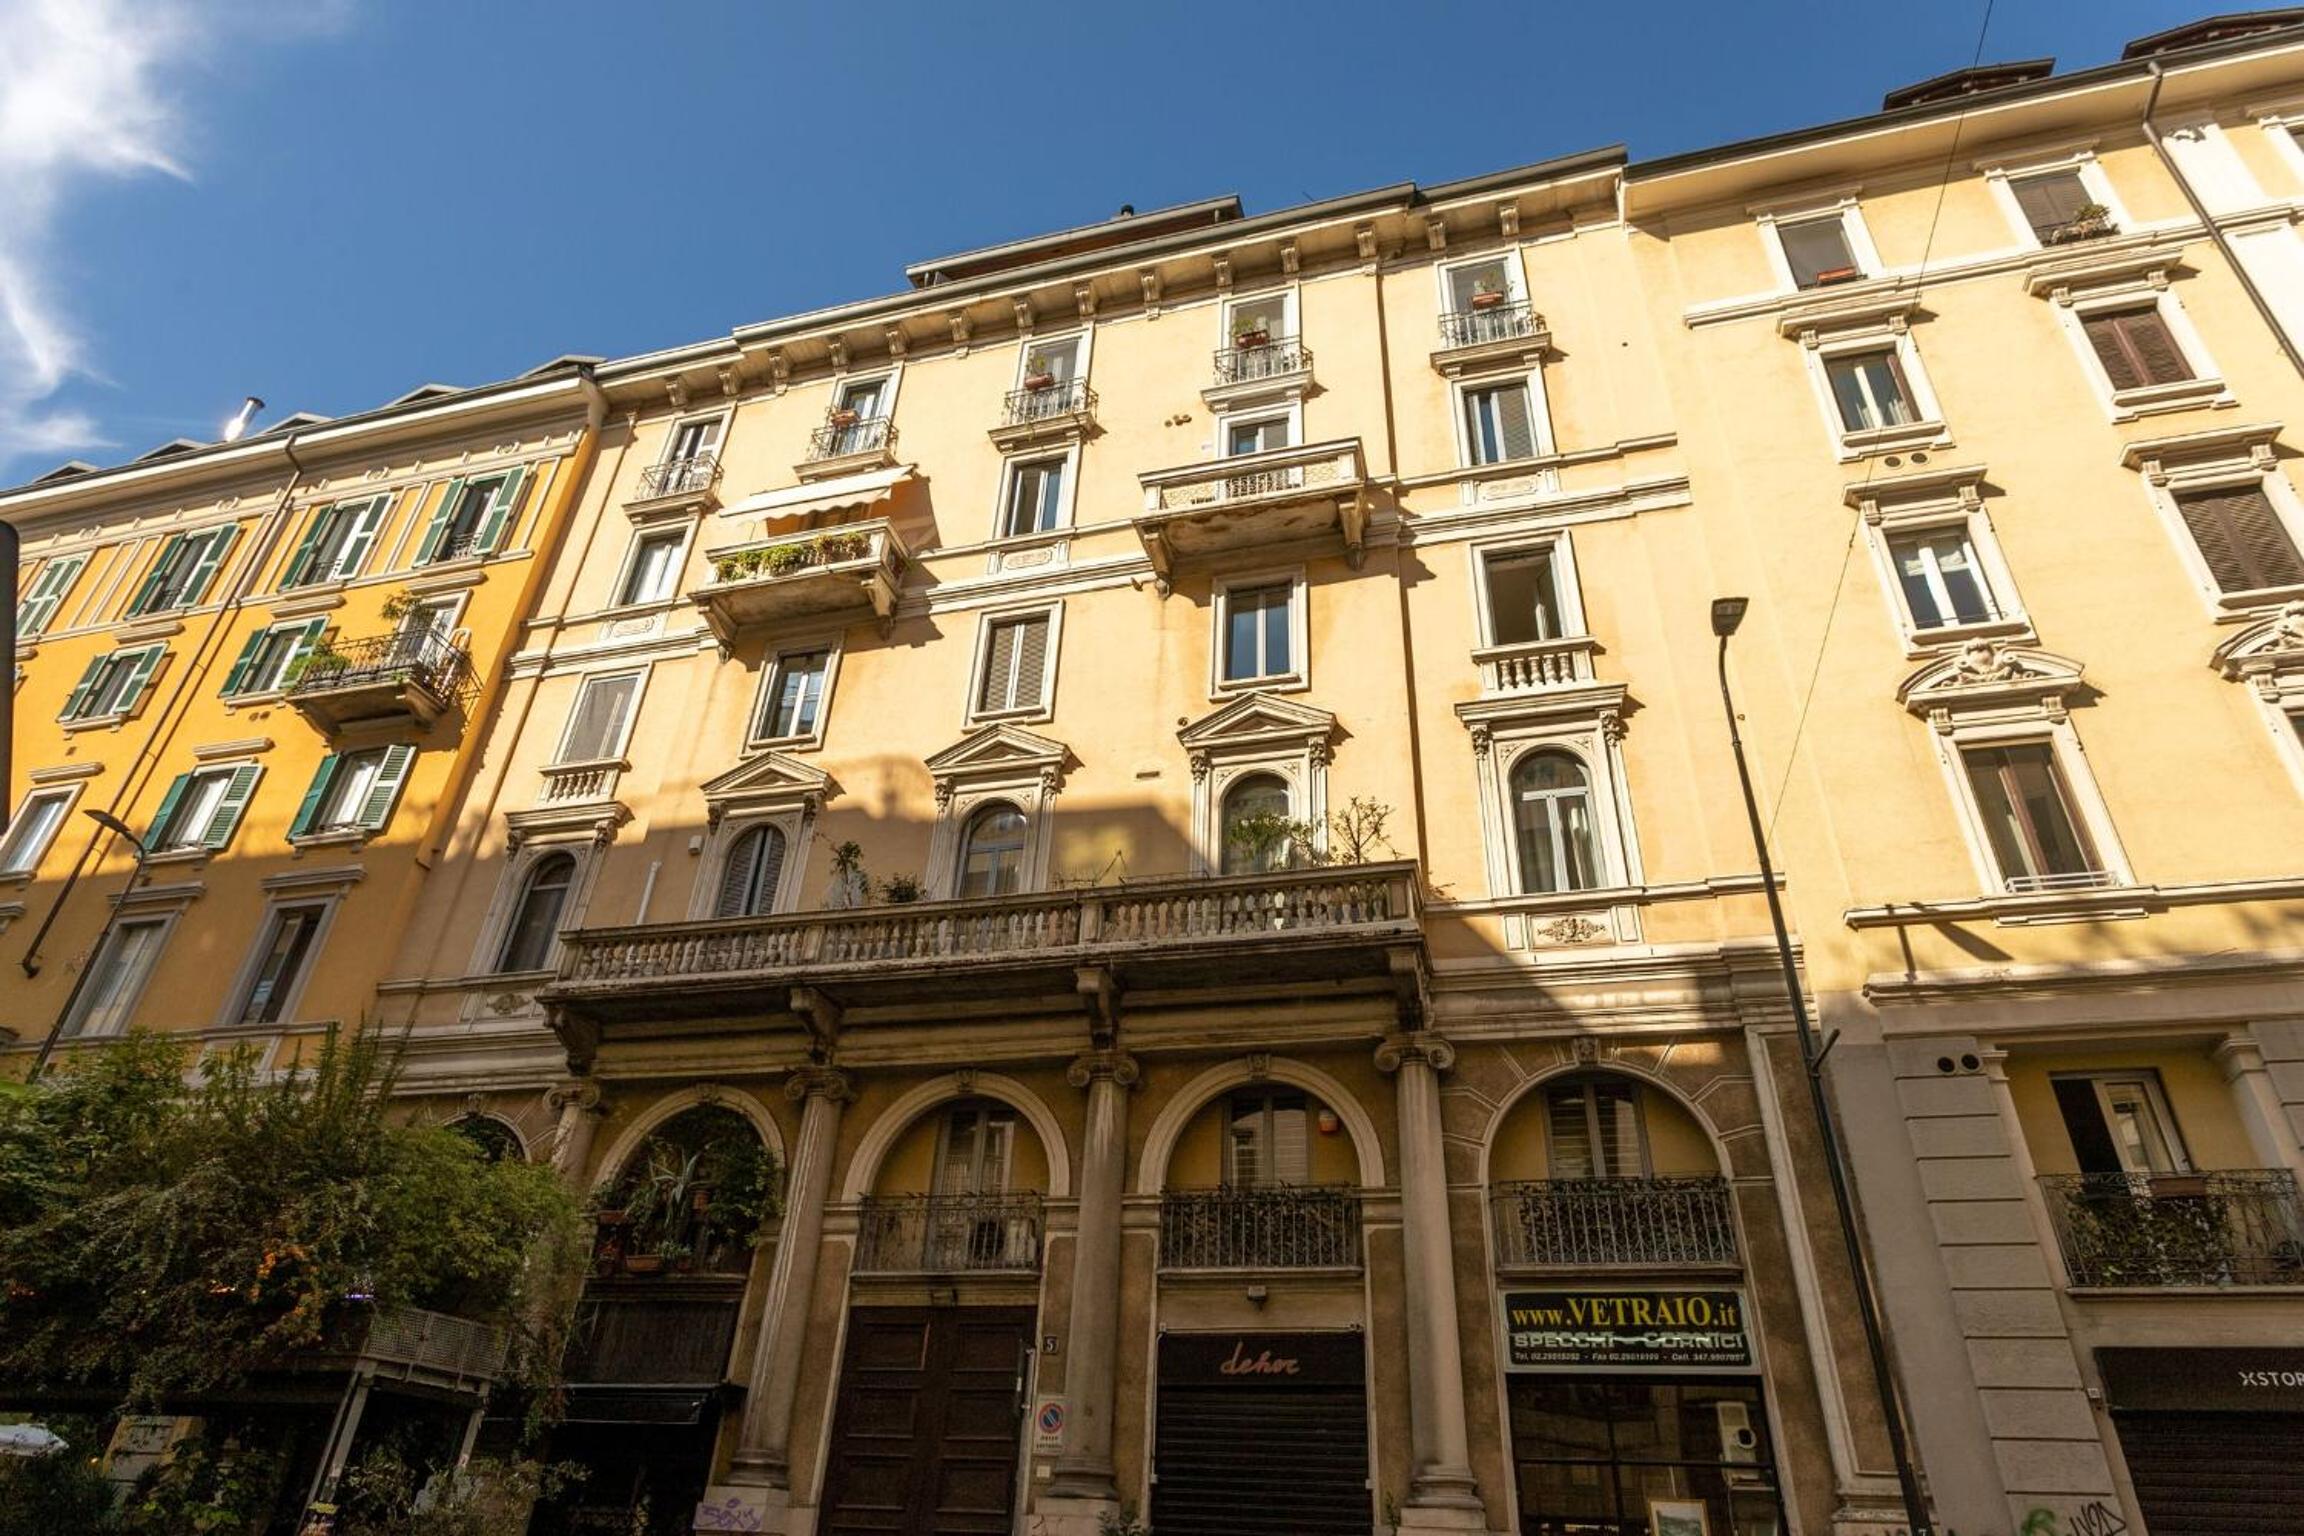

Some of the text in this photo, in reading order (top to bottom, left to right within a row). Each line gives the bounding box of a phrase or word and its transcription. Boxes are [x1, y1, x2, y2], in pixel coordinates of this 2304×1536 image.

[1511, 1297, 1737, 1327] www.VETRAIO.it
[1513, 1331, 1743, 1348] SPECCHI CORNICI
[2238, 1371, 2304, 1387] XSTOR
